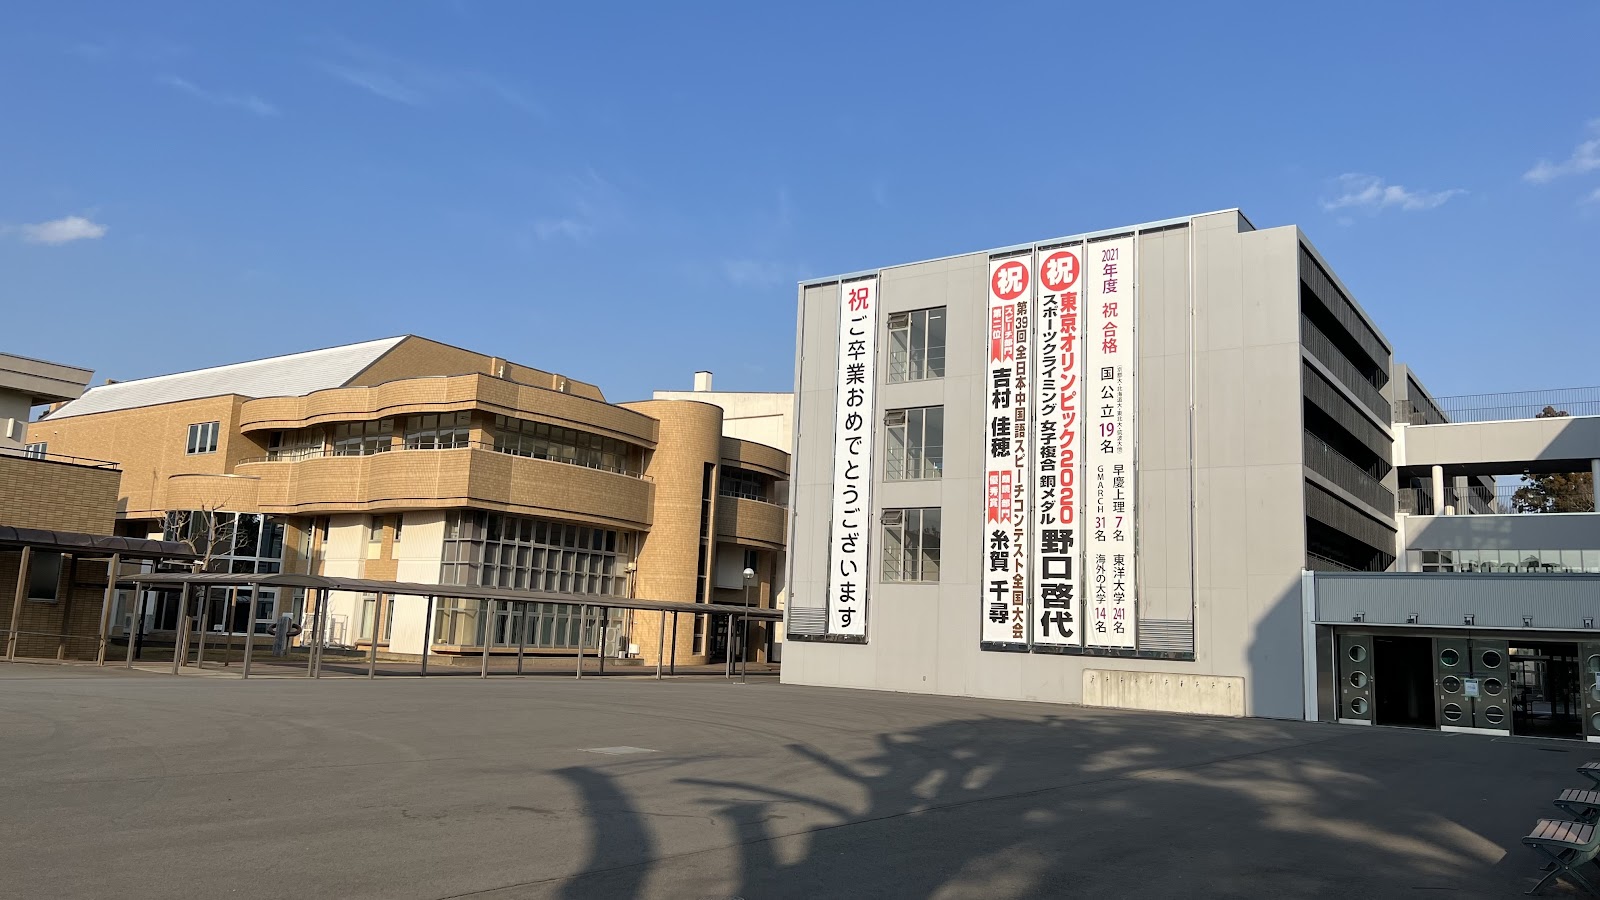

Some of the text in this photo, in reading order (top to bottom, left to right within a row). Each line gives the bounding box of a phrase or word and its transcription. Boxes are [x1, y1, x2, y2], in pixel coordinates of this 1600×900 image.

[997, 266, 1023, 294] 祝
[1046, 256, 1073, 286] 祝
[1059, 291, 1077, 525] 東京オリンピック2020
[1040, 529, 1074, 638] 野口啓代
